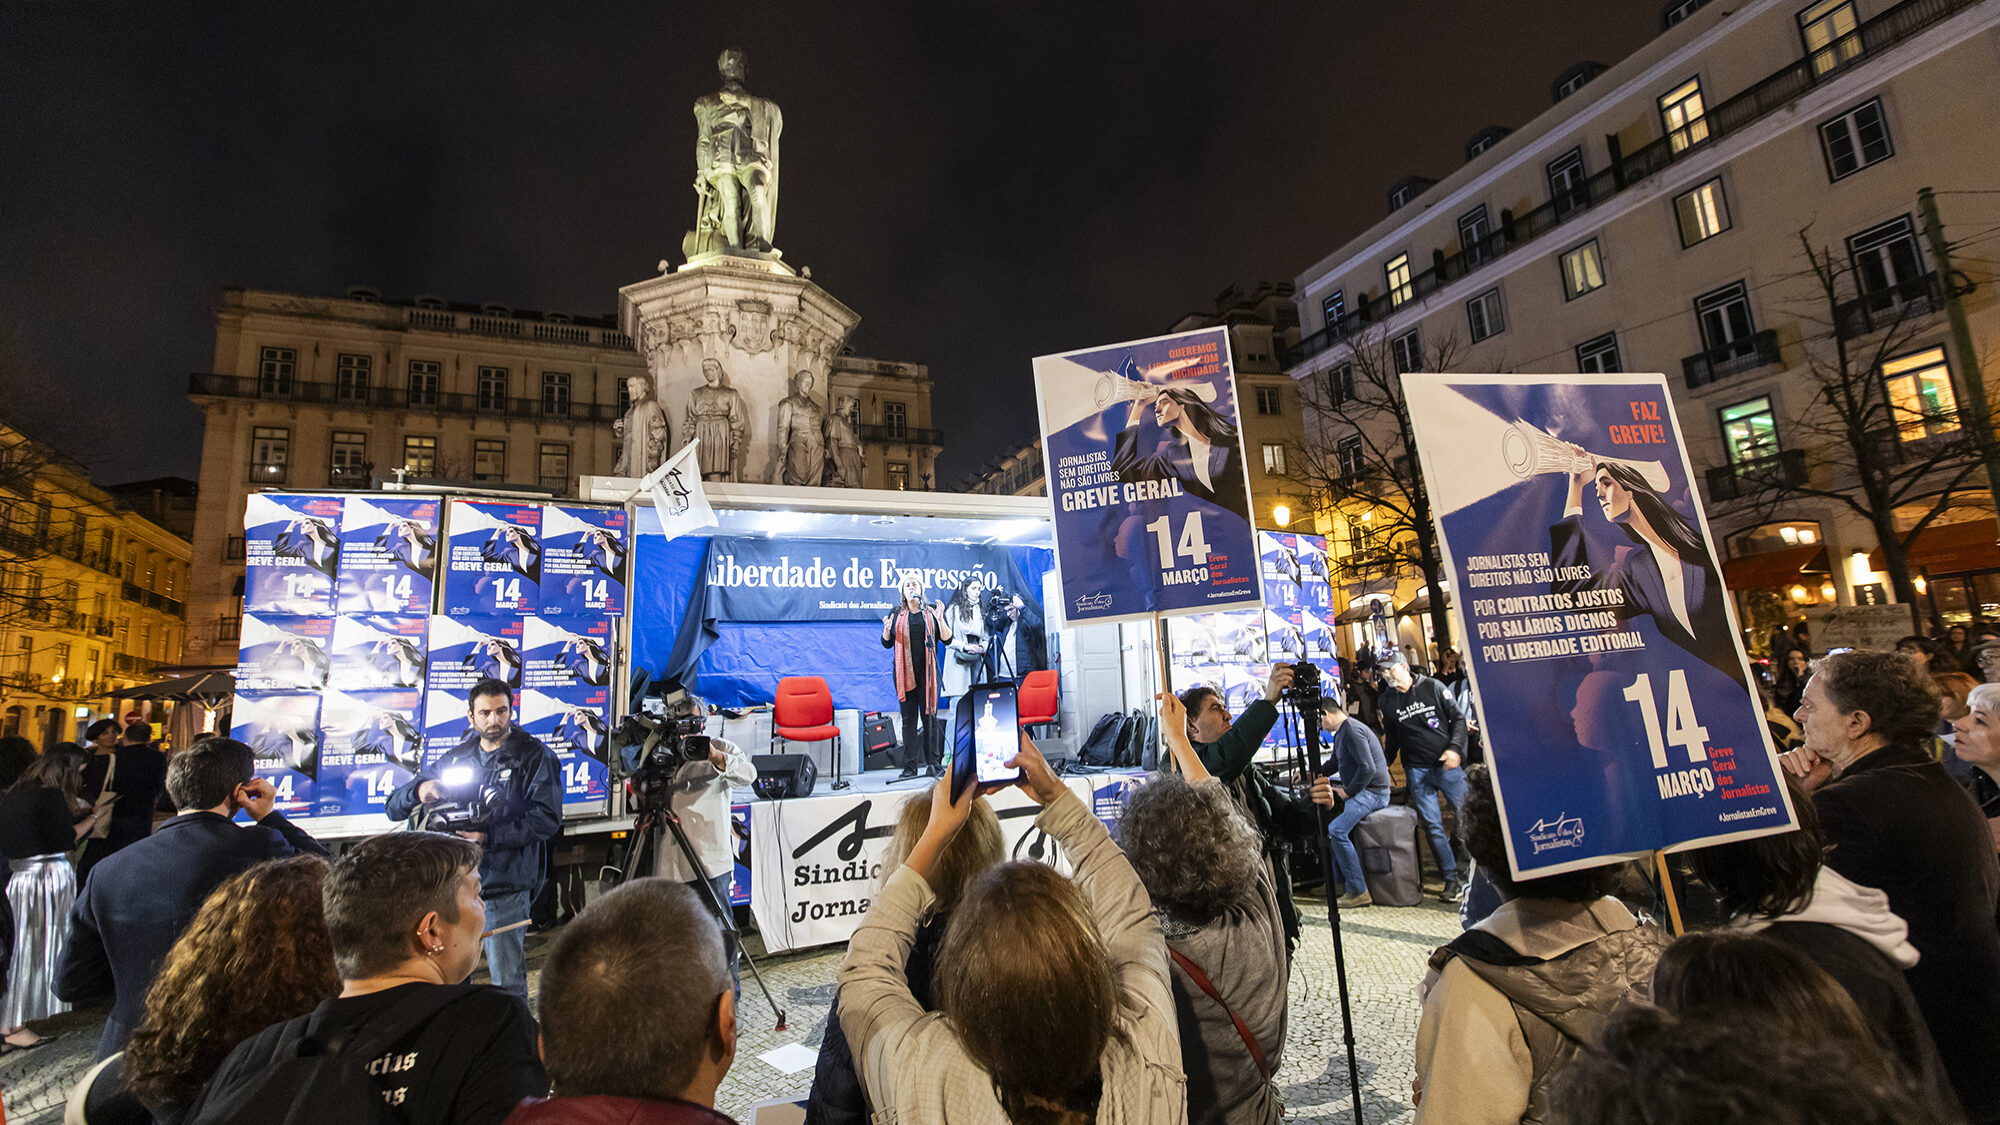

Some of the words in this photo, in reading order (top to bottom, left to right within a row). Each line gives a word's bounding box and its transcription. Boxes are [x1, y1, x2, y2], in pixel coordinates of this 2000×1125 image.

[1169, 342, 1217, 359] QUEREMOS
[1199, 353, 1219, 364] COM
[1172, 363, 1220, 380] DIGNIDADE
[1630, 401, 1661, 420] FAZ
[1609, 424, 1666, 444] GREVE!
[1058, 450, 1107, 468] JORNALISTAS
[1059, 466, 1076, 479] SEM
[1077, 461, 1111, 478] DIREITOS
[1060, 478, 1076, 490] NÃO
[1077, 475, 1092, 487] SÃO
[1093, 470, 1120, 484] LIVRES
[1061, 485, 1120, 512] GREVE
[1123, 477, 1184, 503] GERAL
[1146, 511, 1212, 569] 14
[275, 556, 306, 567] GERAL
[451, 561, 482, 571] GREVE
[483, 562, 513, 572] GERAL
[1467, 554, 1527, 571] JORNALISTAS
[1528, 552, 1550, 567] SEM
[842, 557, 874, 589] de
[1162, 567, 1209, 586] MARÇO
[1211, 576, 1250, 586] Jornalistas
[1469, 570, 1512, 588] DIREITOS
[1514, 569, 1532, 585] NÃO
[1533, 567, 1553, 583] SÃO
[1555, 565, 1592, 582] LIVRES
[283, 573, 315, 598] 14
[382, 574, 413, 599] 14
[492, 578, 522, 602] 14
[581, 579, 609, 602] 14
[1282, 584, 1295, 600] 14
[1316, 585, 1329, 602] 14
[819, 600, 847, 609] Sindicato
[860, 602, 893, 610] Jornalistas
[1473, 599, 1497, 616] POR
[1497, 593, 1573, 615] CONTRATOS
[1575, 588, 1625, 608] JUSTOS
[1477, 622, 1502, 639] POR
[1502, 615, 1564, 637] SALÁRIOS
[1564, 611, 1617, 631] DIGNOS
[1483, 645, 1507, 663] POR
[1506, 638, 1579, 661] LIBERDADE
[1580, 631, 1646, 653] EDITORIAL
[1622, 669, 1710, 769] 14
[322, 755, 353, 766] GREVE
[355, 753, 387, 764] GERAL
[1708, 746, 1734, 759] Greve
[562, 761, 591, 787] 14
[1712, 758, 1736, 772] Geral
[363, 770, 395, 796] 14
[566, 785, 588, 794] MARÇO
[1656, 767, 1715, 800] MARÇO
[1717, 774, 1734, 786] dos
[1721, 784, 1770, 800] Jornalistas
[1719, 806, 1777, 822] #JornalistasEmGreve
